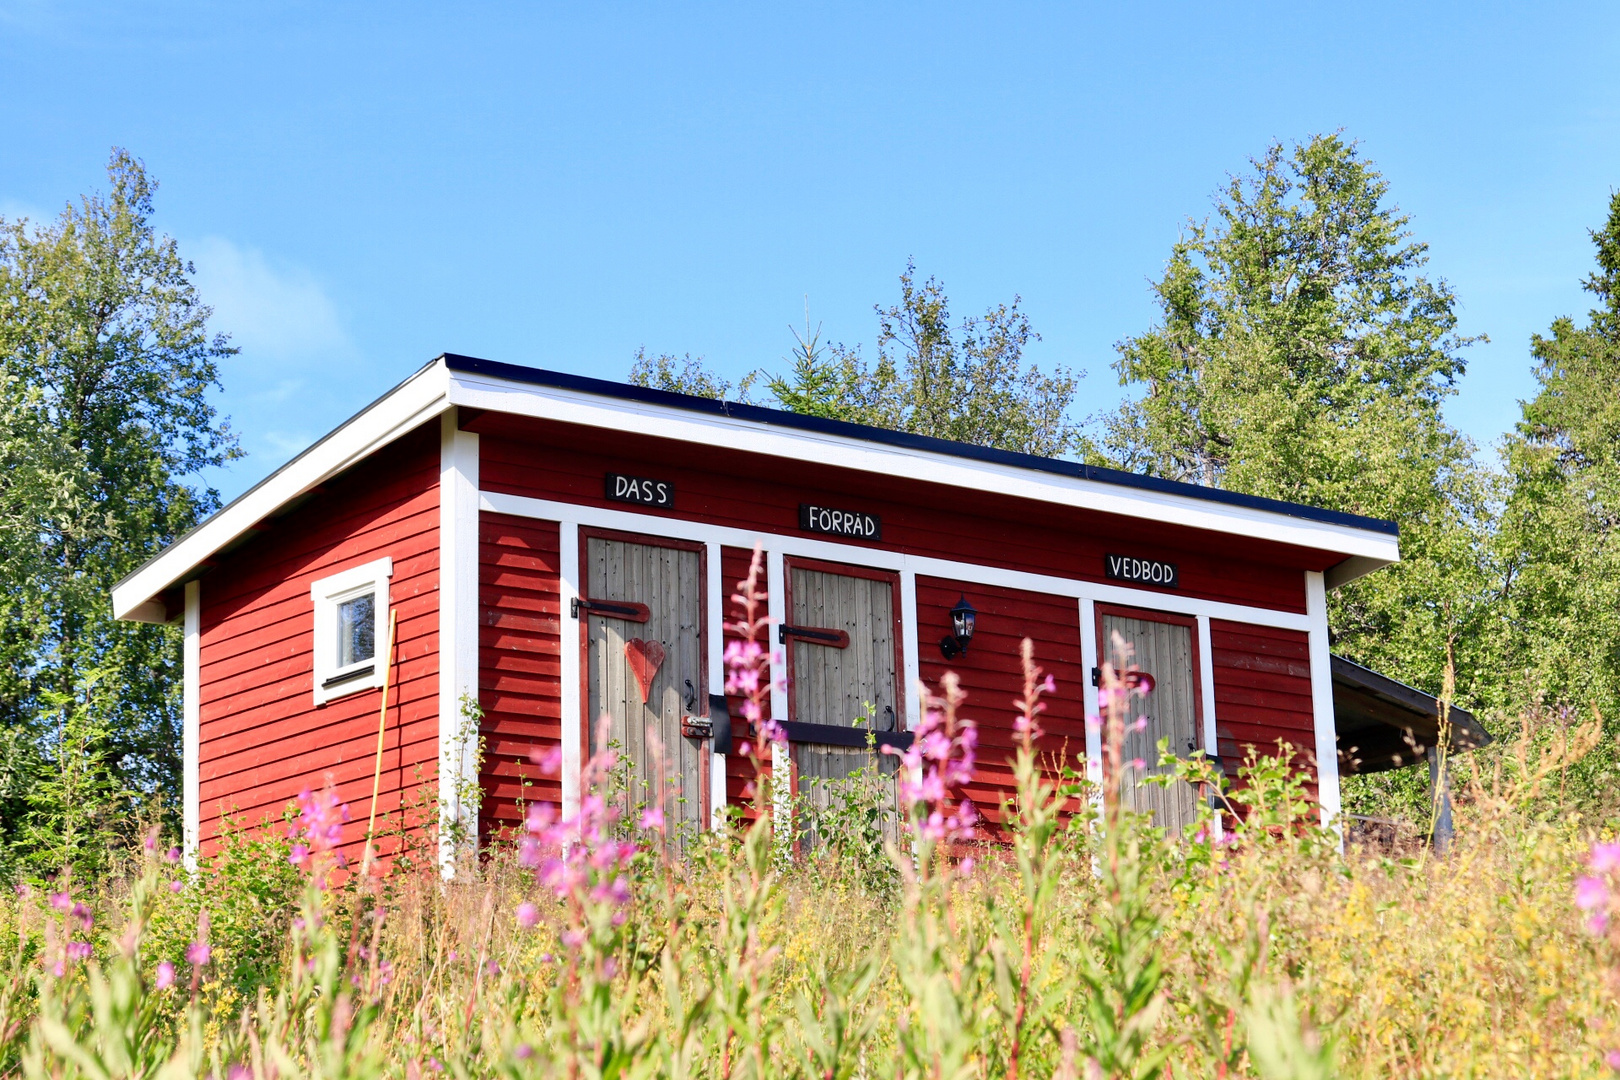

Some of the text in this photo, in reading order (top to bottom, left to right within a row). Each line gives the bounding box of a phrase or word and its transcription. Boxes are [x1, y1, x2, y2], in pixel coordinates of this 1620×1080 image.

[615, 476, 667, 504] DASS
[809, 506, 875, 536] FÖRRÅD
[1110, 555, 1174, 583] VEDBOD
